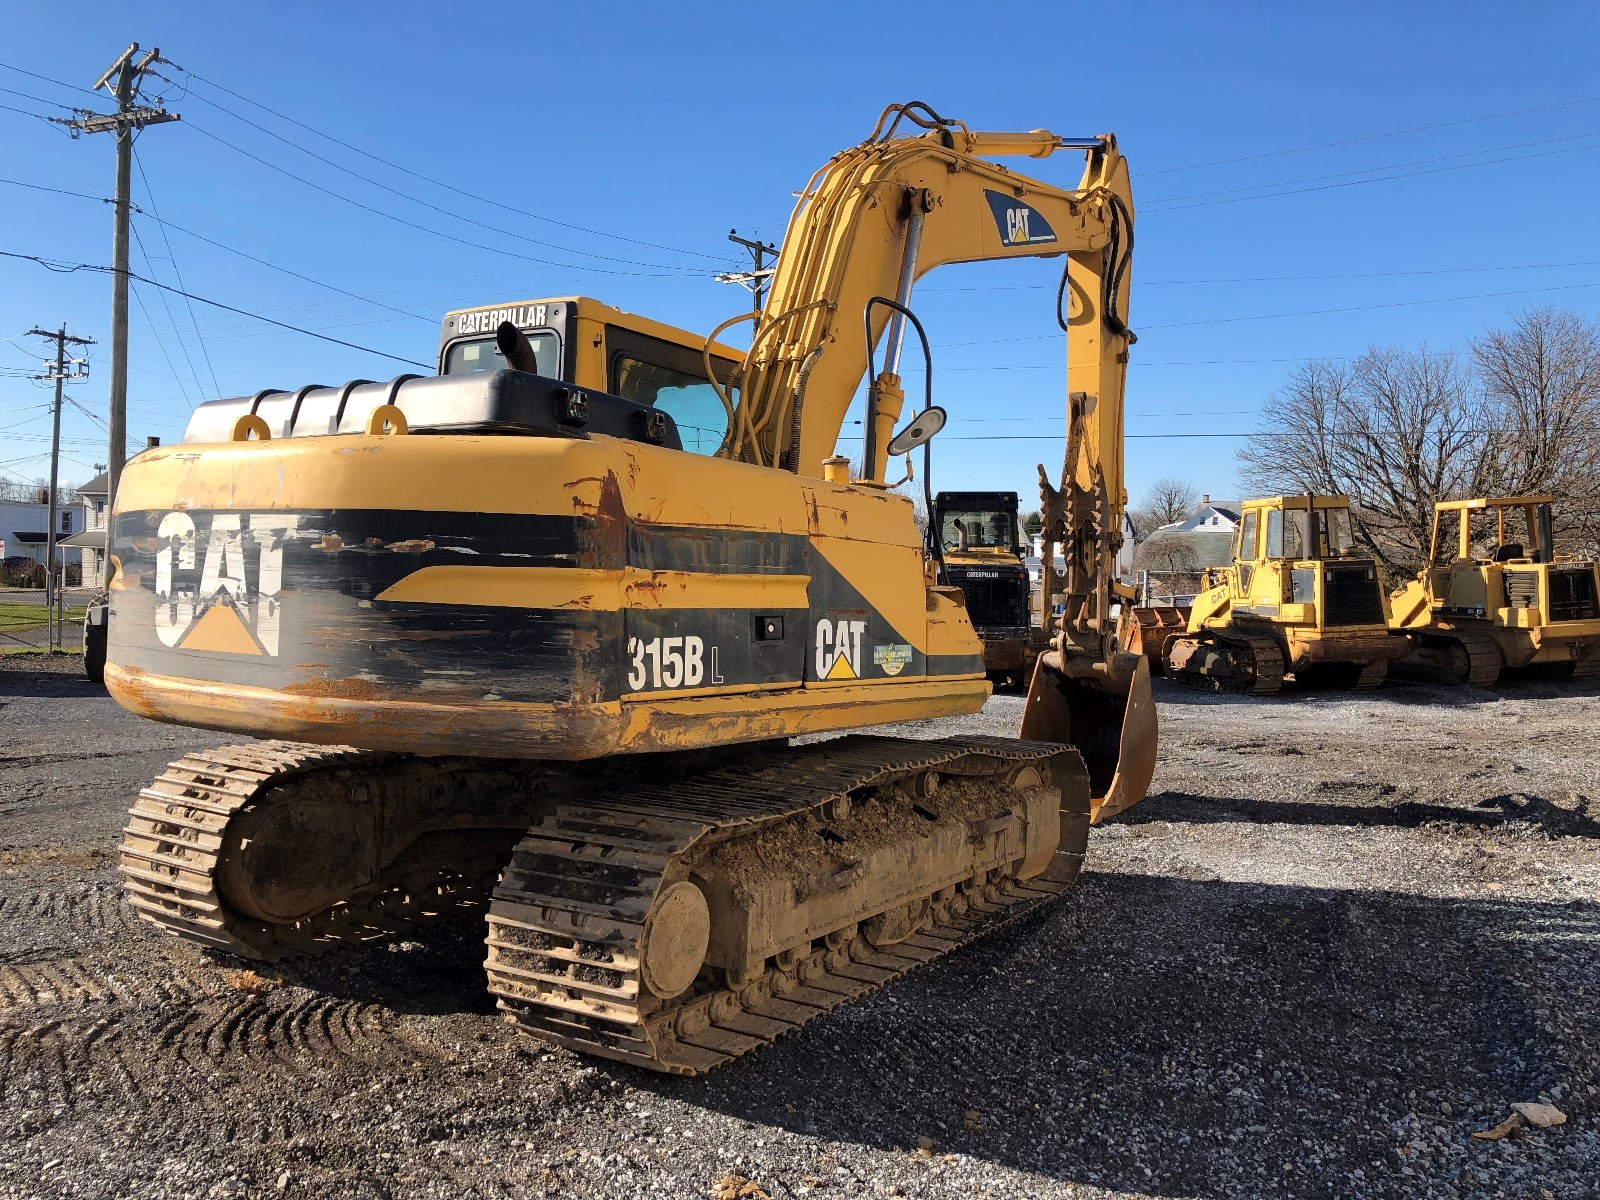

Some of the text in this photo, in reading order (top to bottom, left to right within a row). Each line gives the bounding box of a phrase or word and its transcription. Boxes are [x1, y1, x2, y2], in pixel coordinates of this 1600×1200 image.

[1006, 208, 1029, 243] CAT
[155, 511, 298, 657] CAT
[1211, 588, 1226, 604] CAT
[627, 635, 724, 691] 315B L
[815, 618, 865, 680] CAT
